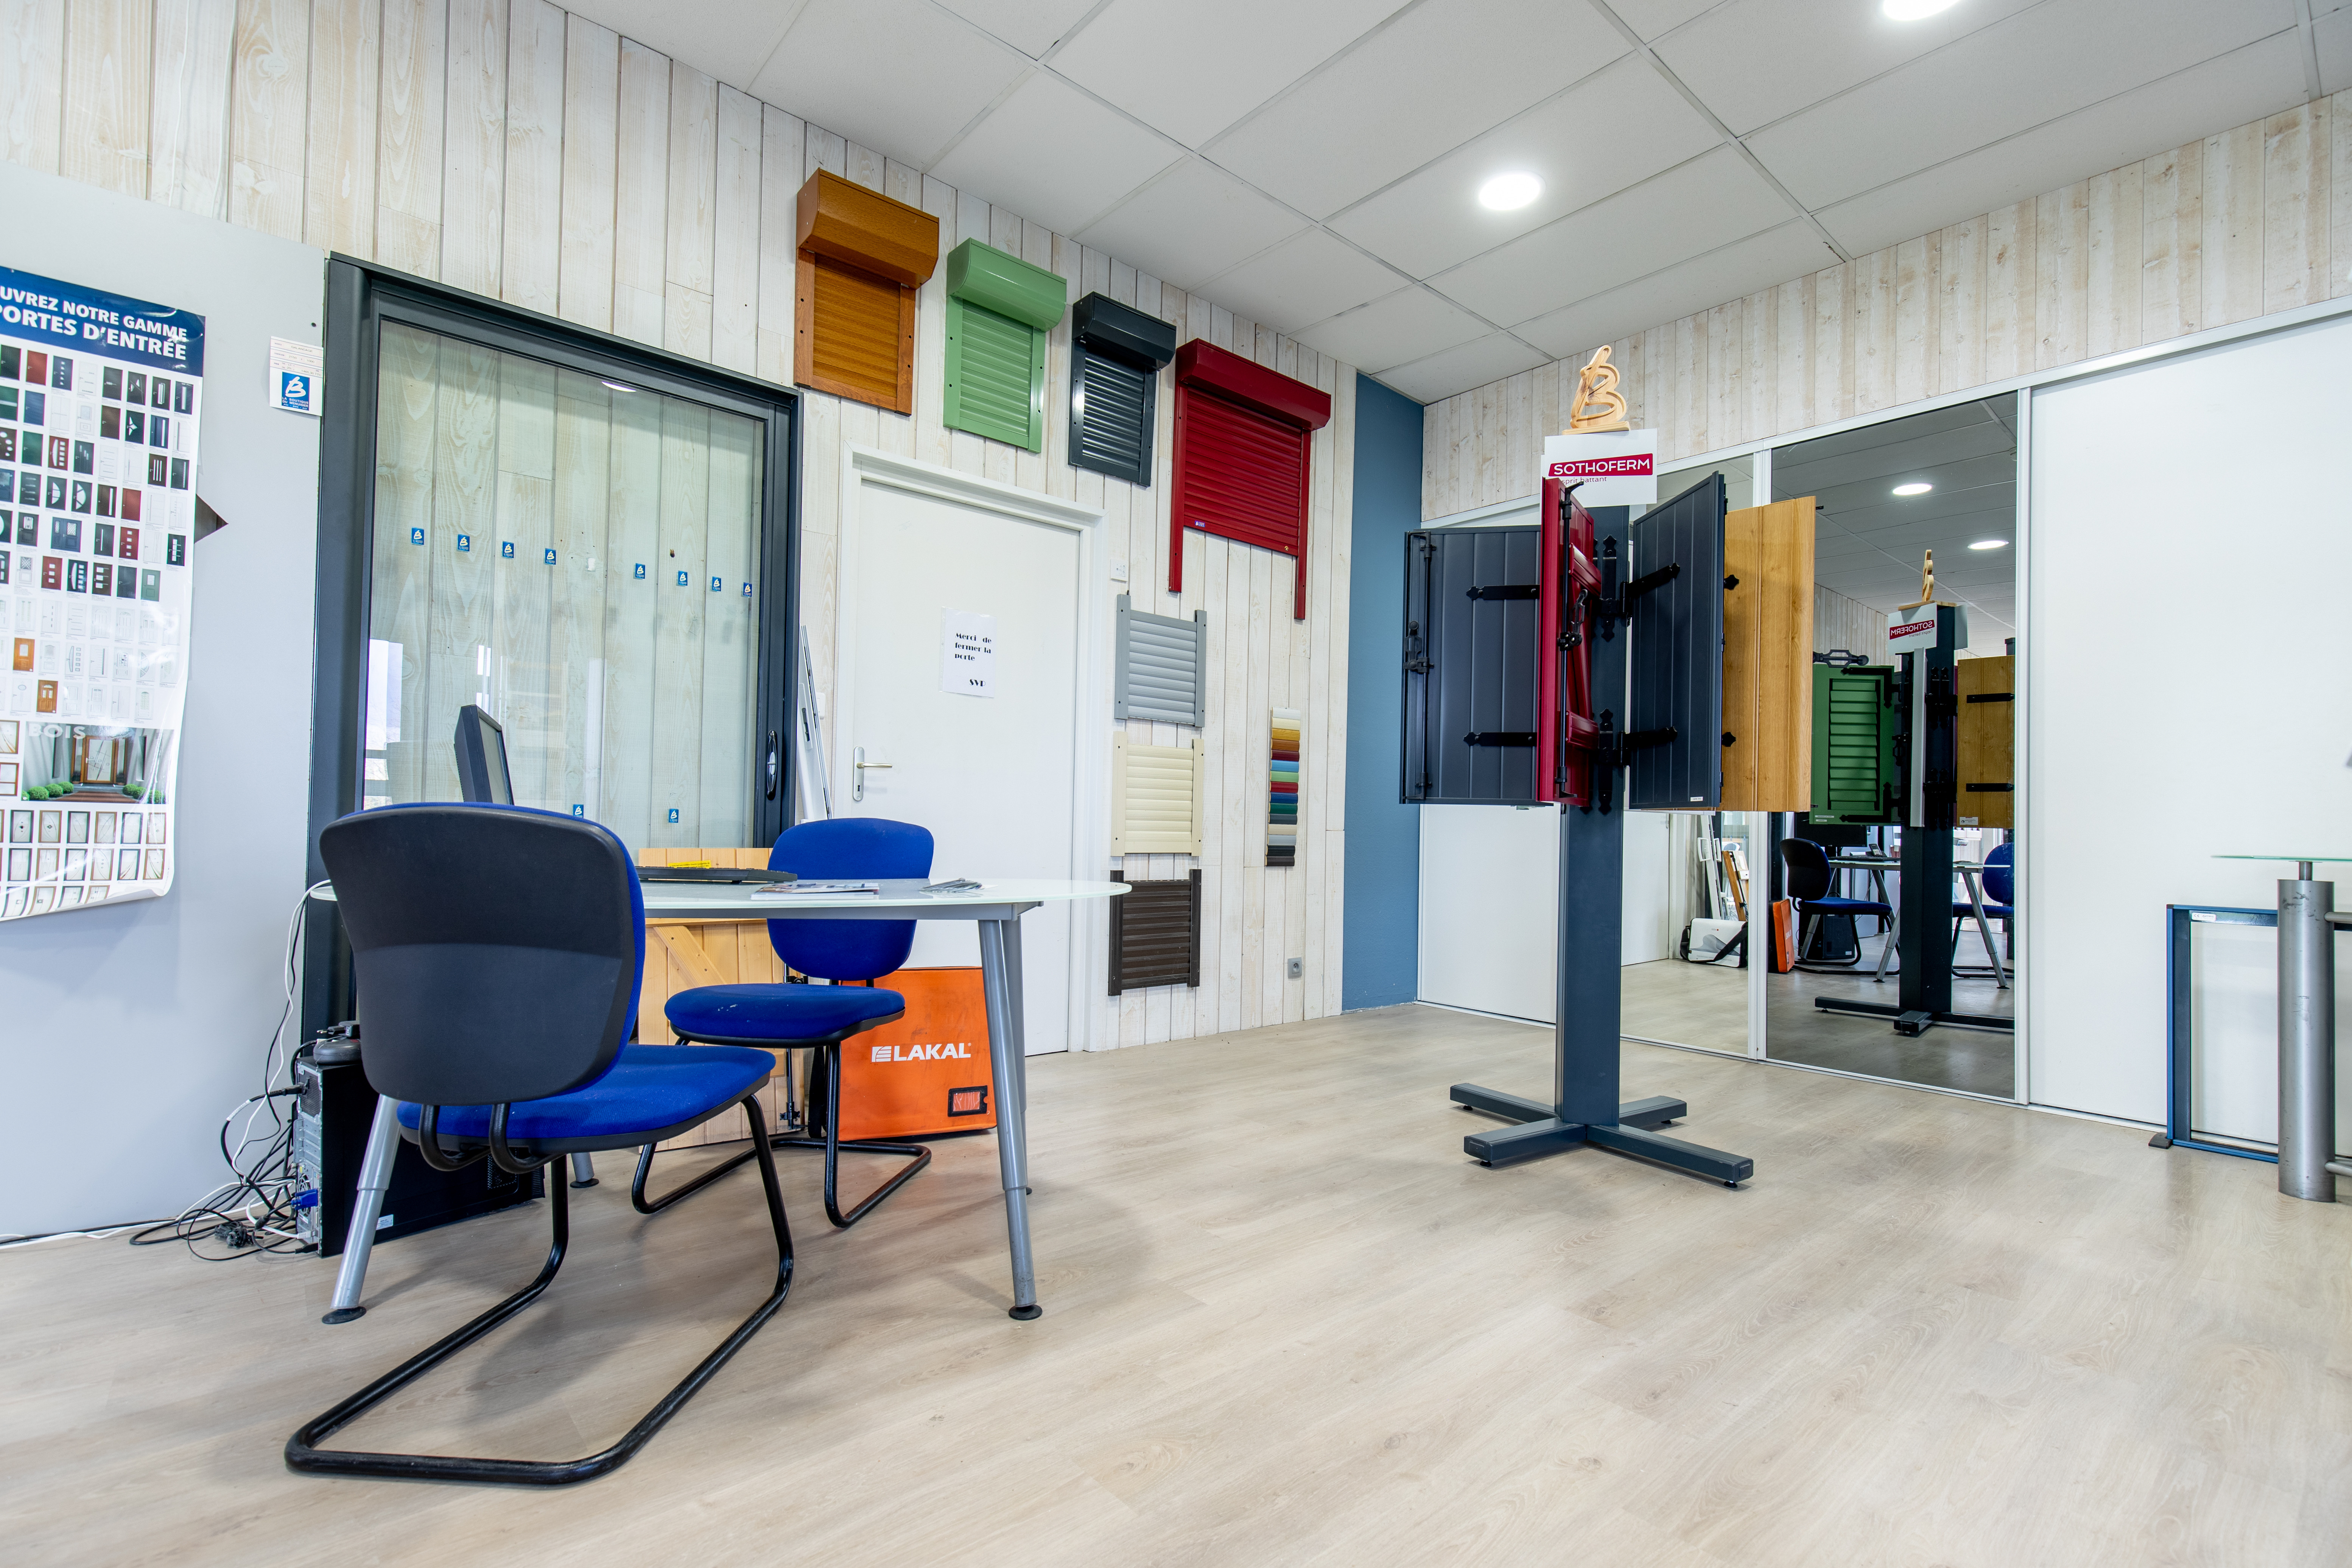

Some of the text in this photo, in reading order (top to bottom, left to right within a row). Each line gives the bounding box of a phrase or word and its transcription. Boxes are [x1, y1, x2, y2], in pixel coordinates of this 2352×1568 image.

[62, 300, 119, 325] NOTRE
[123, 315, 187, 341] GAMME
[0, 304, 186, 360] ORTES D'ENTRÉE
[285, 376, 306, 397] B
[1554, 458, 1650, 475] SOTHOFERM
[955, 632, 976, 641] Merci
[955, 642, 982, 652] fermer
[969, 679, 986, 687] SVP
[29, 723, 86, 739] BOIS
